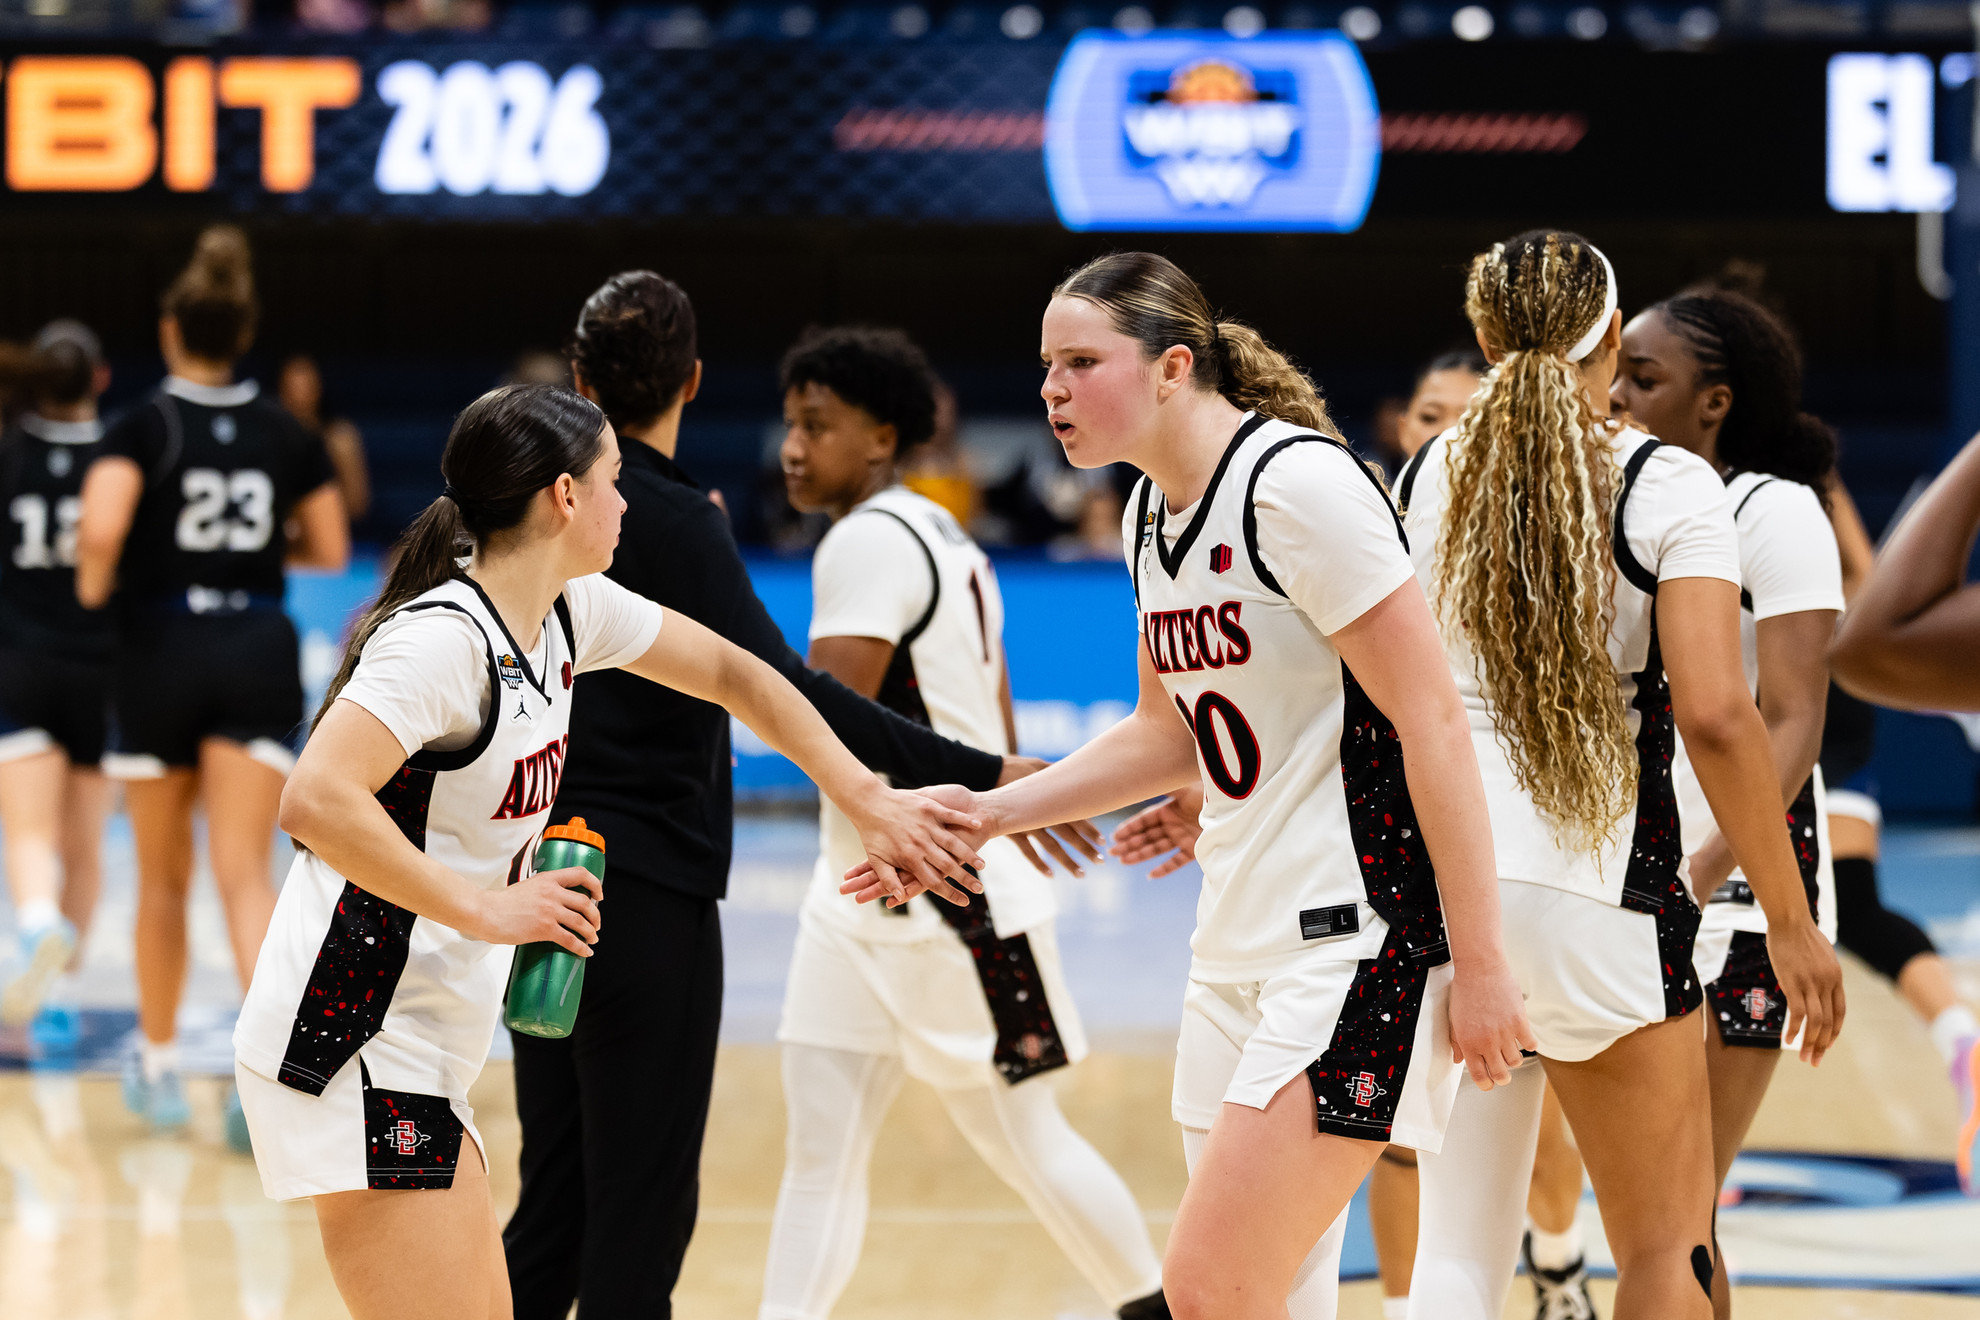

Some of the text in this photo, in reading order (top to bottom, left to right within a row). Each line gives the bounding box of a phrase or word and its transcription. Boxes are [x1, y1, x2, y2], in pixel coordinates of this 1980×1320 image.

[0, 55, 611, 196] BIT 2026
[1826, 52, 1980, 213] EL
[175, 467, 274, 552] 23
[500, 666, 523, 678] WBIT
[1340, 914, 1348, 926] L
